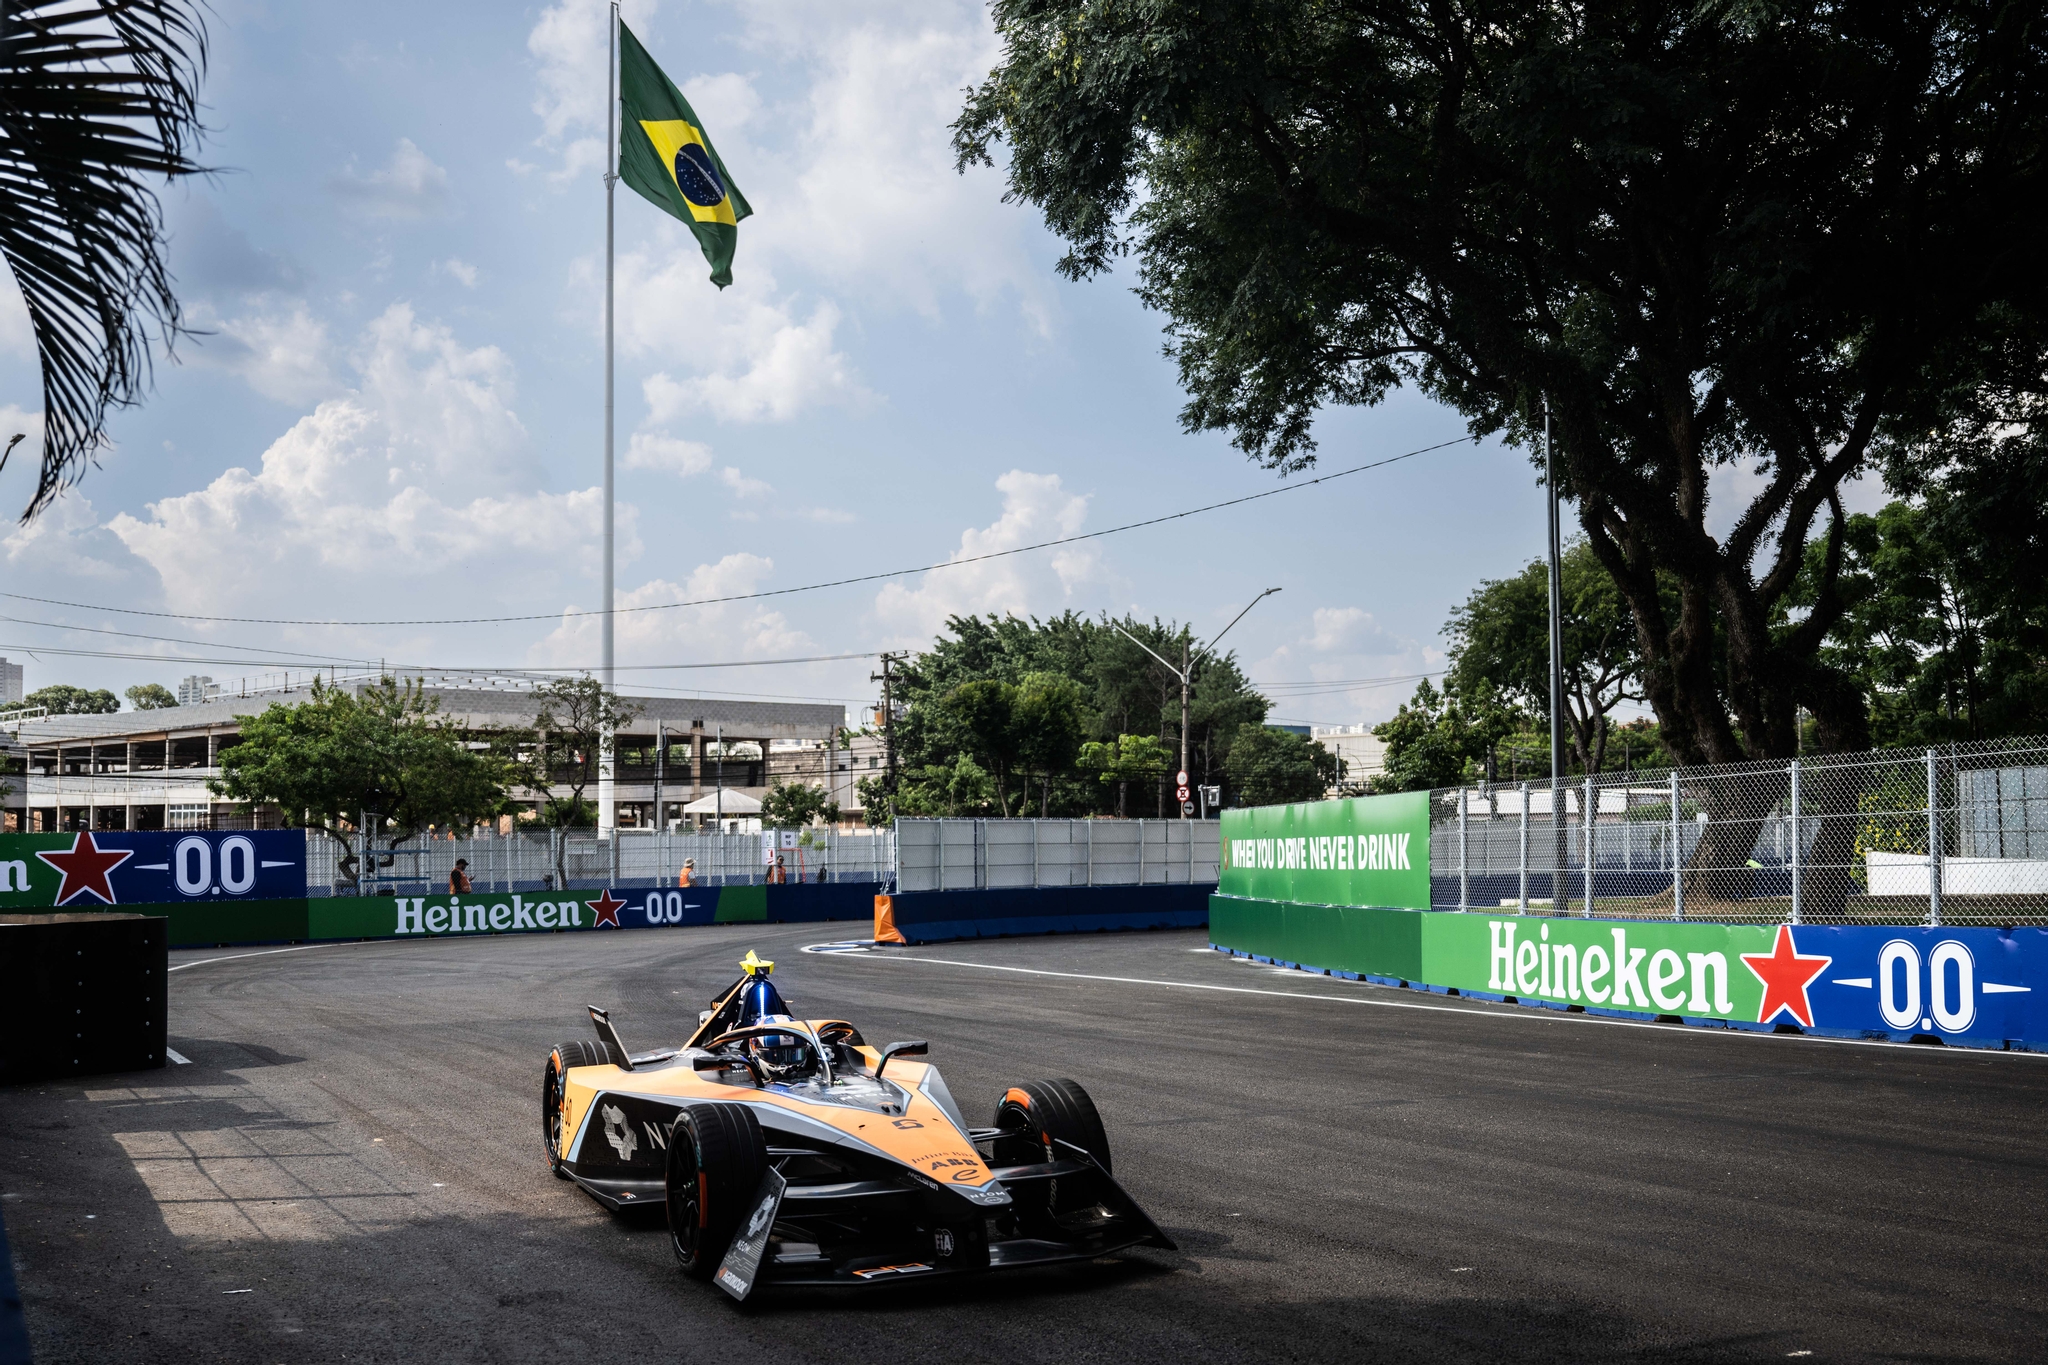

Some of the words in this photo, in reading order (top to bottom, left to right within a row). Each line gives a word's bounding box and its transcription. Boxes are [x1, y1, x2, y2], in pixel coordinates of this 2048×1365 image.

[174, 837, 255, 896] 0.0
[1256, 838, 1275, 870] YOU
[1277, 837, 1307, 870] DRIVE
[1309, 835, 1355, 871] NEVER
[1357, 833, 1412, 871] DRINK
[394, 895, 582, 934] Heineken
[646, 891, 683, 924] 0.0
[1488, 920, 1734, 1014] Heineken
[1877, 938, 1976, 1033] 0.0
[931, 1158, 979, 1171] ABB
[970, 1191, 1005, 1199] NEOM
[935, 1233, 952, 1251] FIA
